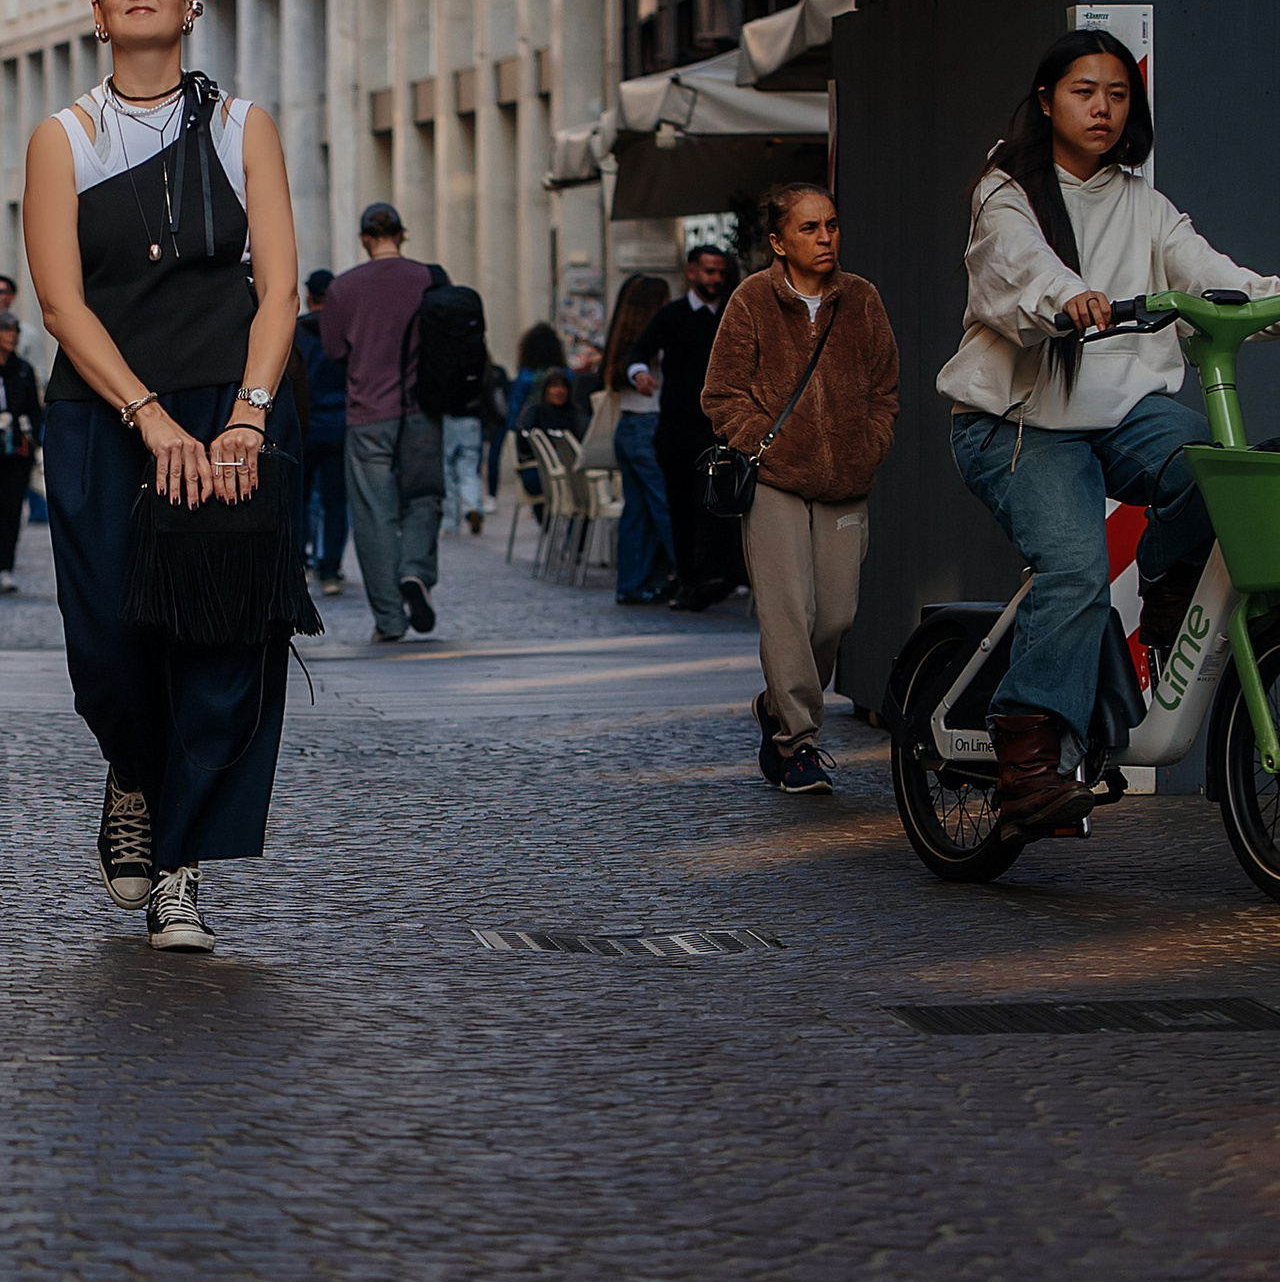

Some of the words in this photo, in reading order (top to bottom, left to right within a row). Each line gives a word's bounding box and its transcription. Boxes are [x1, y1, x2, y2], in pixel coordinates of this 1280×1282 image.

[1154, 604, 1210, 711] Lime
[955, 738, 970, 752] On
[971, 738, 994, 753] Lime
